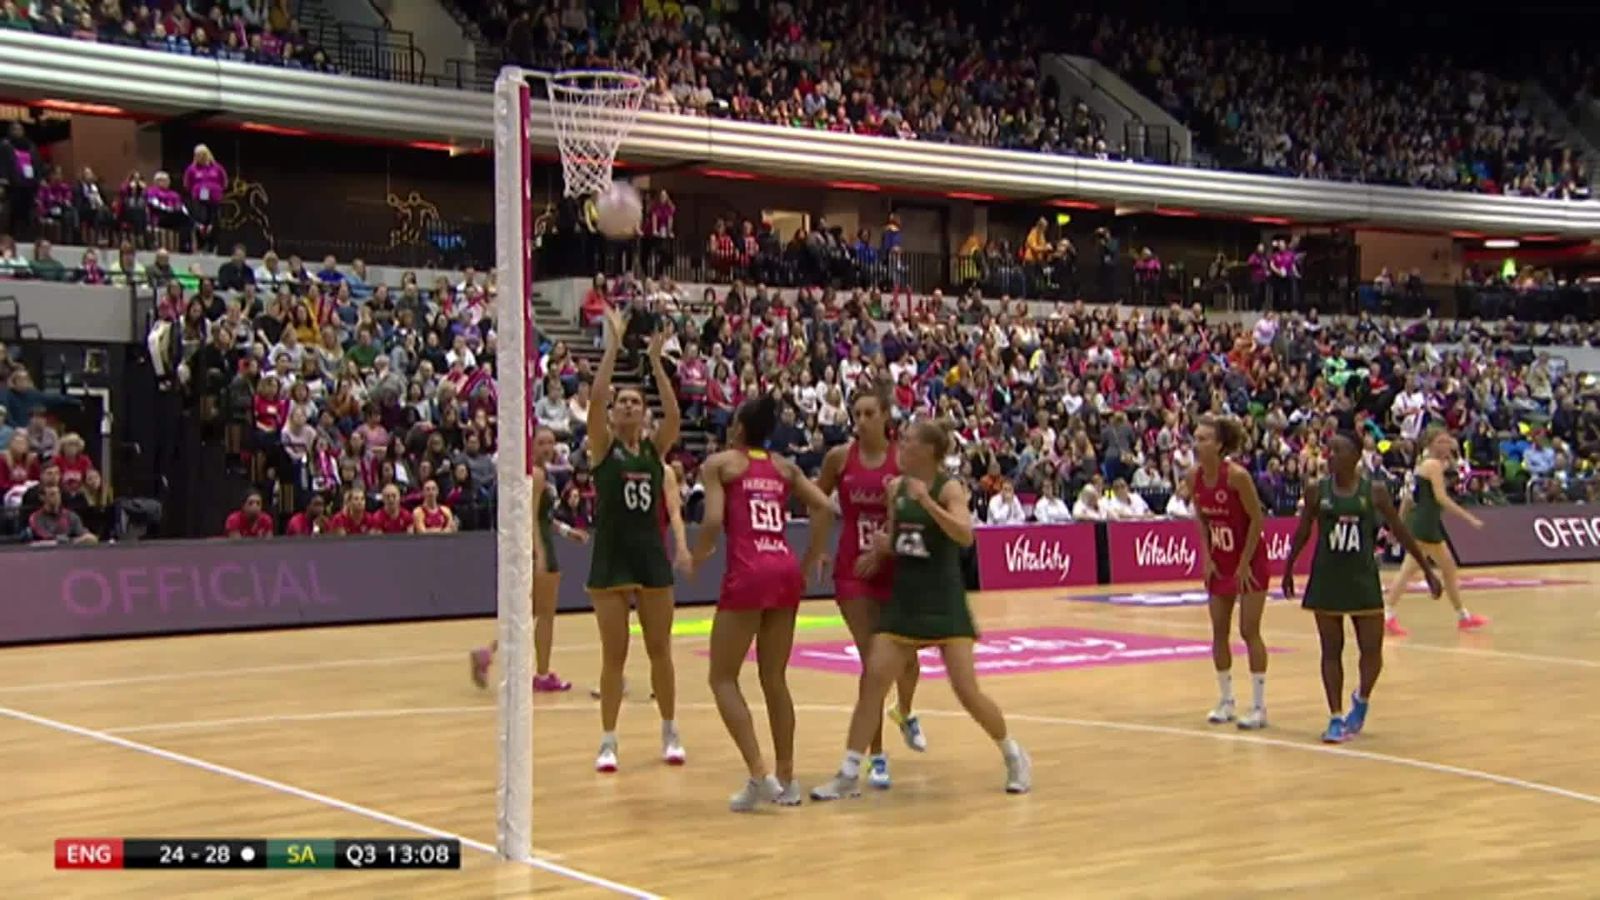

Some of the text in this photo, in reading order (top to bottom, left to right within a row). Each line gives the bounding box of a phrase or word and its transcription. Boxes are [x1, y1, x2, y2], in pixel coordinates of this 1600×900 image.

[624, 480, 652, 512] GS
[1005, 533, 1071, 583] Vitality
[1135, 529, 1197, 576] Vitality
[1329, 523, 1361, 552] WA
[61, 559, 341, 618] OFFICIAL
